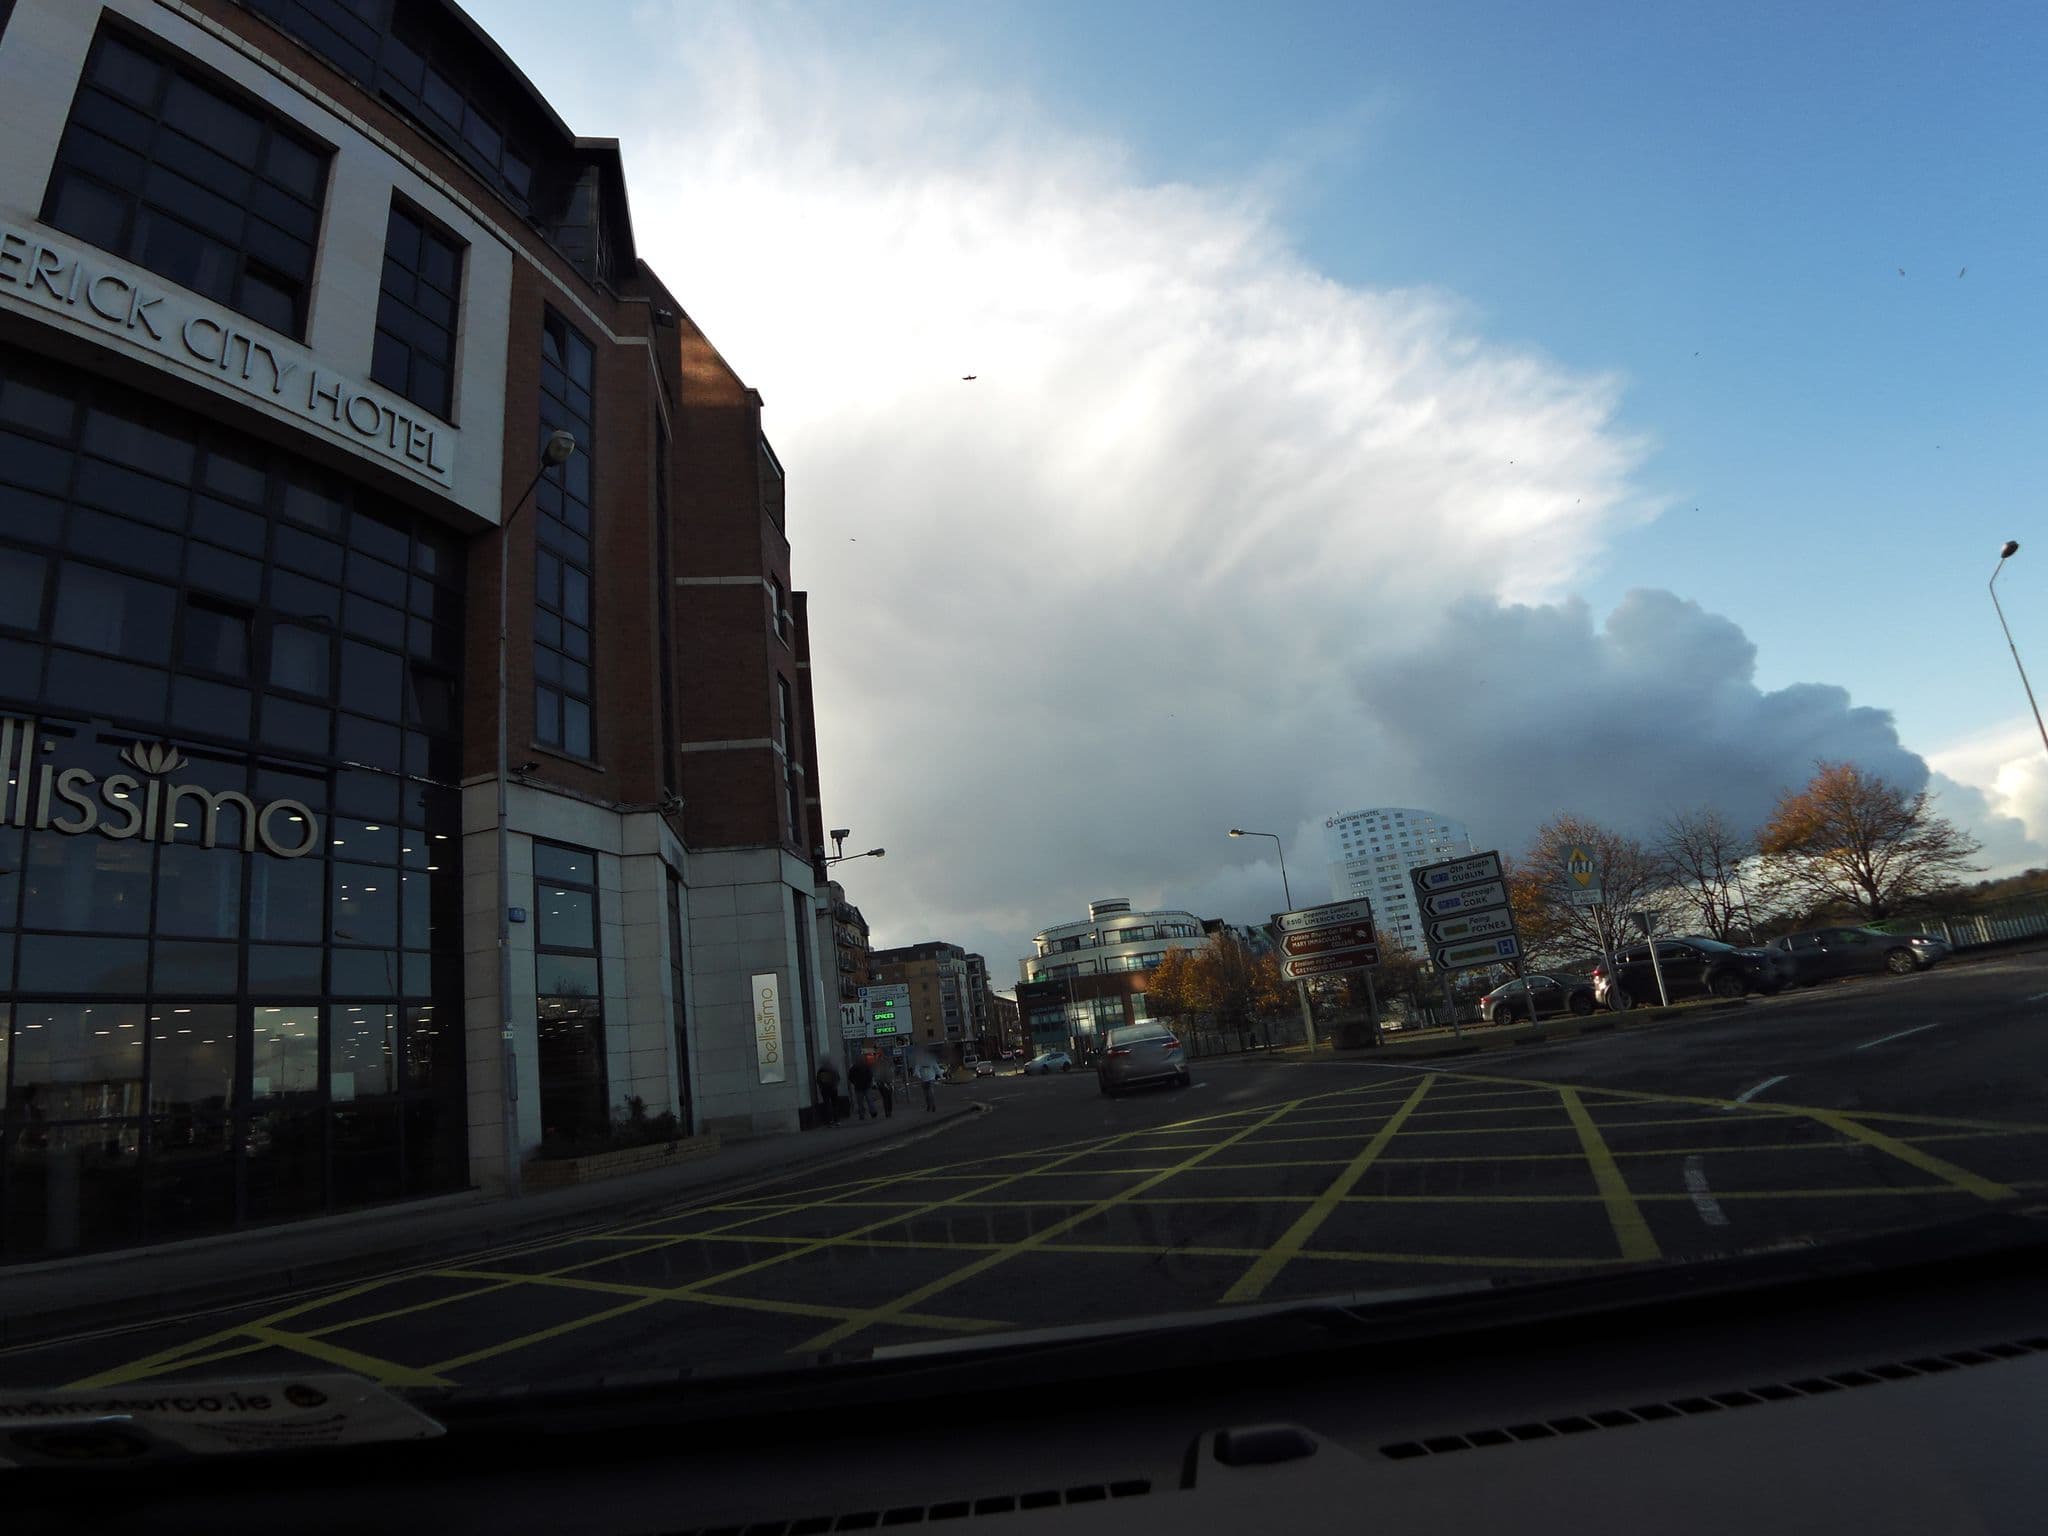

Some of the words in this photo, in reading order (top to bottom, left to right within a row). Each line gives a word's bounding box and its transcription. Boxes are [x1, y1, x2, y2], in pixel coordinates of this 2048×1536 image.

[183, 318, 297, 393] CITY
[308, 371, 446, 473] HOTEL
[1453, 870, 1485, 882] DUBLIN
[1463, 897, 1488, 907] CORK
[1305, 914, 1336, 926] LIMERICK
[1337, 910, 1360, 920] DOCKS
[1471, 920, 1506, 933] FOYNES
[759, 987, 778, 1065] bellissimo
